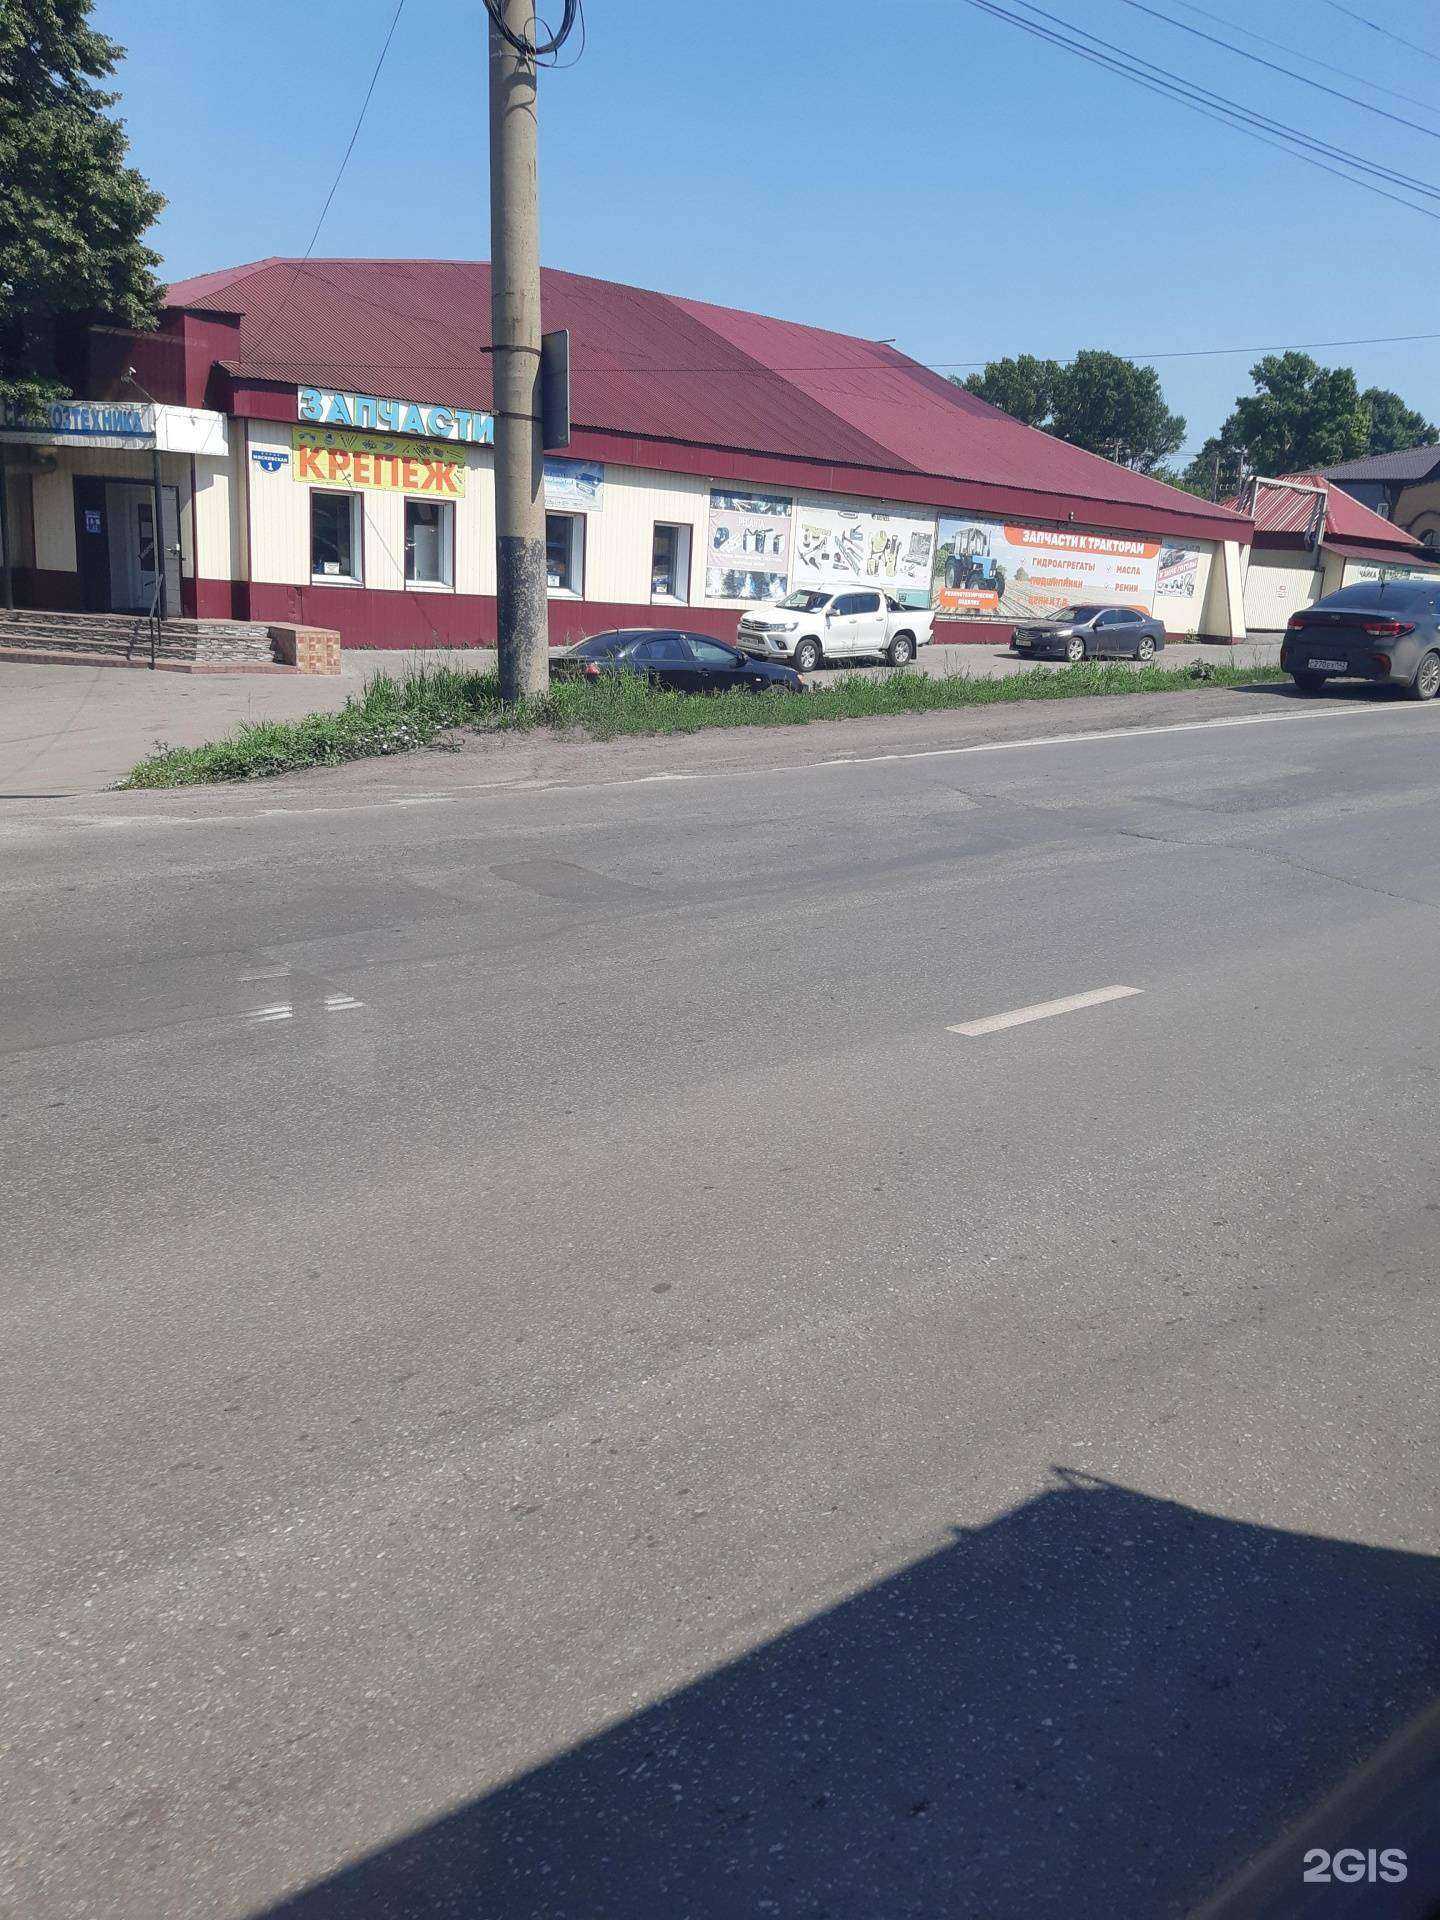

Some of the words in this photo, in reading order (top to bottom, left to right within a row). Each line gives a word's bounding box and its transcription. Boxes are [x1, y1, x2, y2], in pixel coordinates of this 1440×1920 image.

[300, 387, 495, 444] ЗАПЧАСТИ
[267, 462, 274, 471] 1
[299, 444, 458, 493] КРЕПЕЖ
[1022, 530, 1079, 548] ЗАПЧАСТИ
[1079, 537, 1086, 548] К
[1087, 538, 1145, 554] ТРАКТОРАМ
[1032, 557, 1096, 572] ГИДРОАГРЕГАТЫ
[1115, 565, 1142, 576] МАСЛА
[1114, 583, 1139, 594] РЕМНИ
